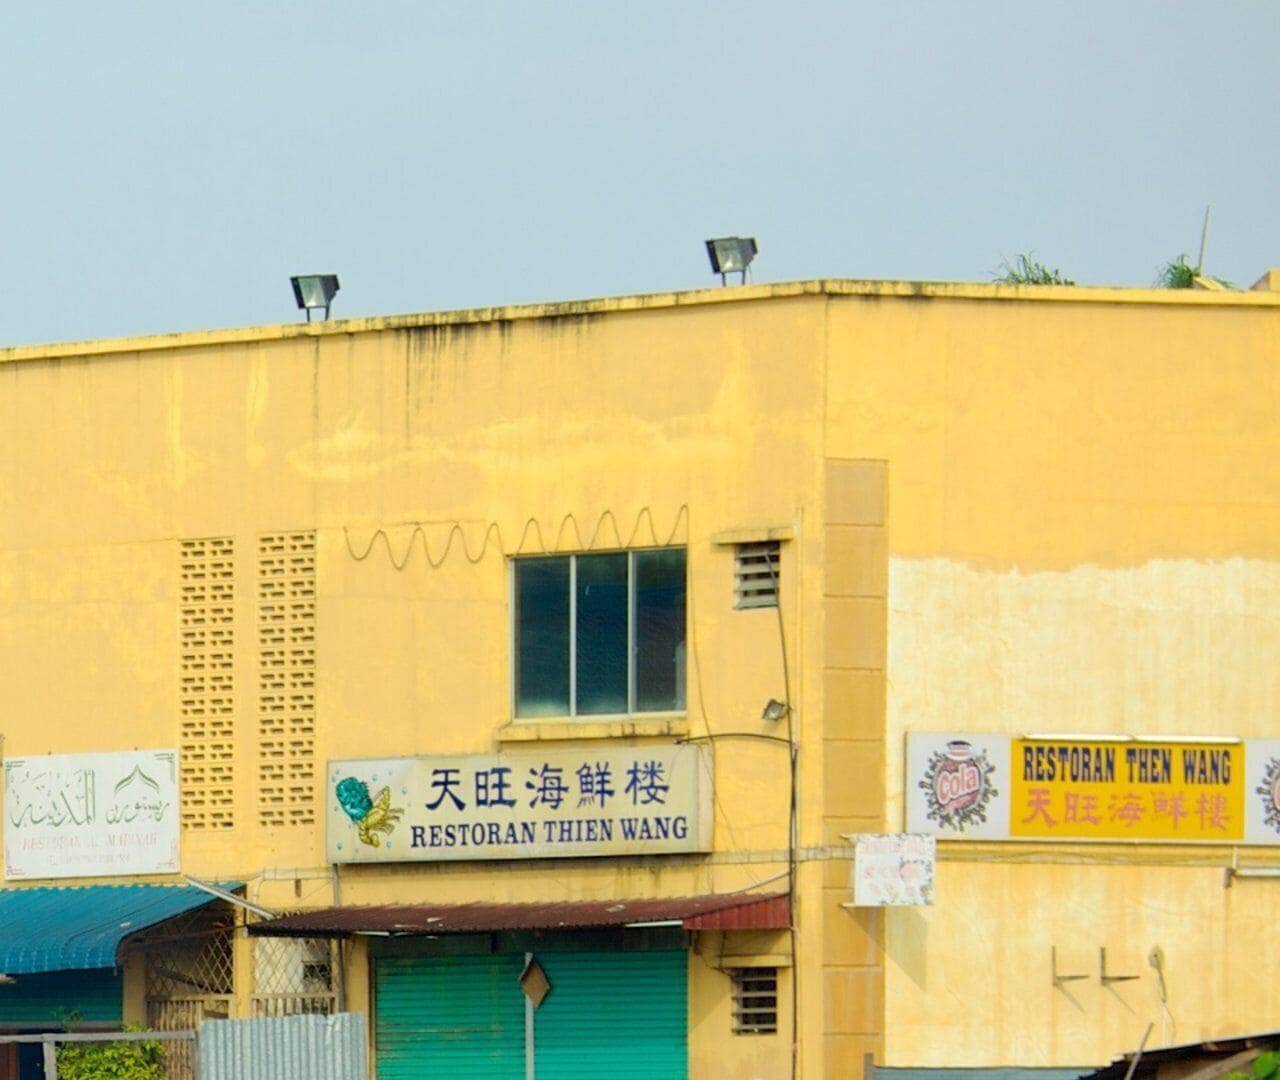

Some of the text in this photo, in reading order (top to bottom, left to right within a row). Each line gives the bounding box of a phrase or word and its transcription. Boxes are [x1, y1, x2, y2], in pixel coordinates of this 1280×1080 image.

[1023, 746, 1232, 784] RESTORAN THEN WANG
[411, 816, 689, 848] RESTORAN THIEN WANG
